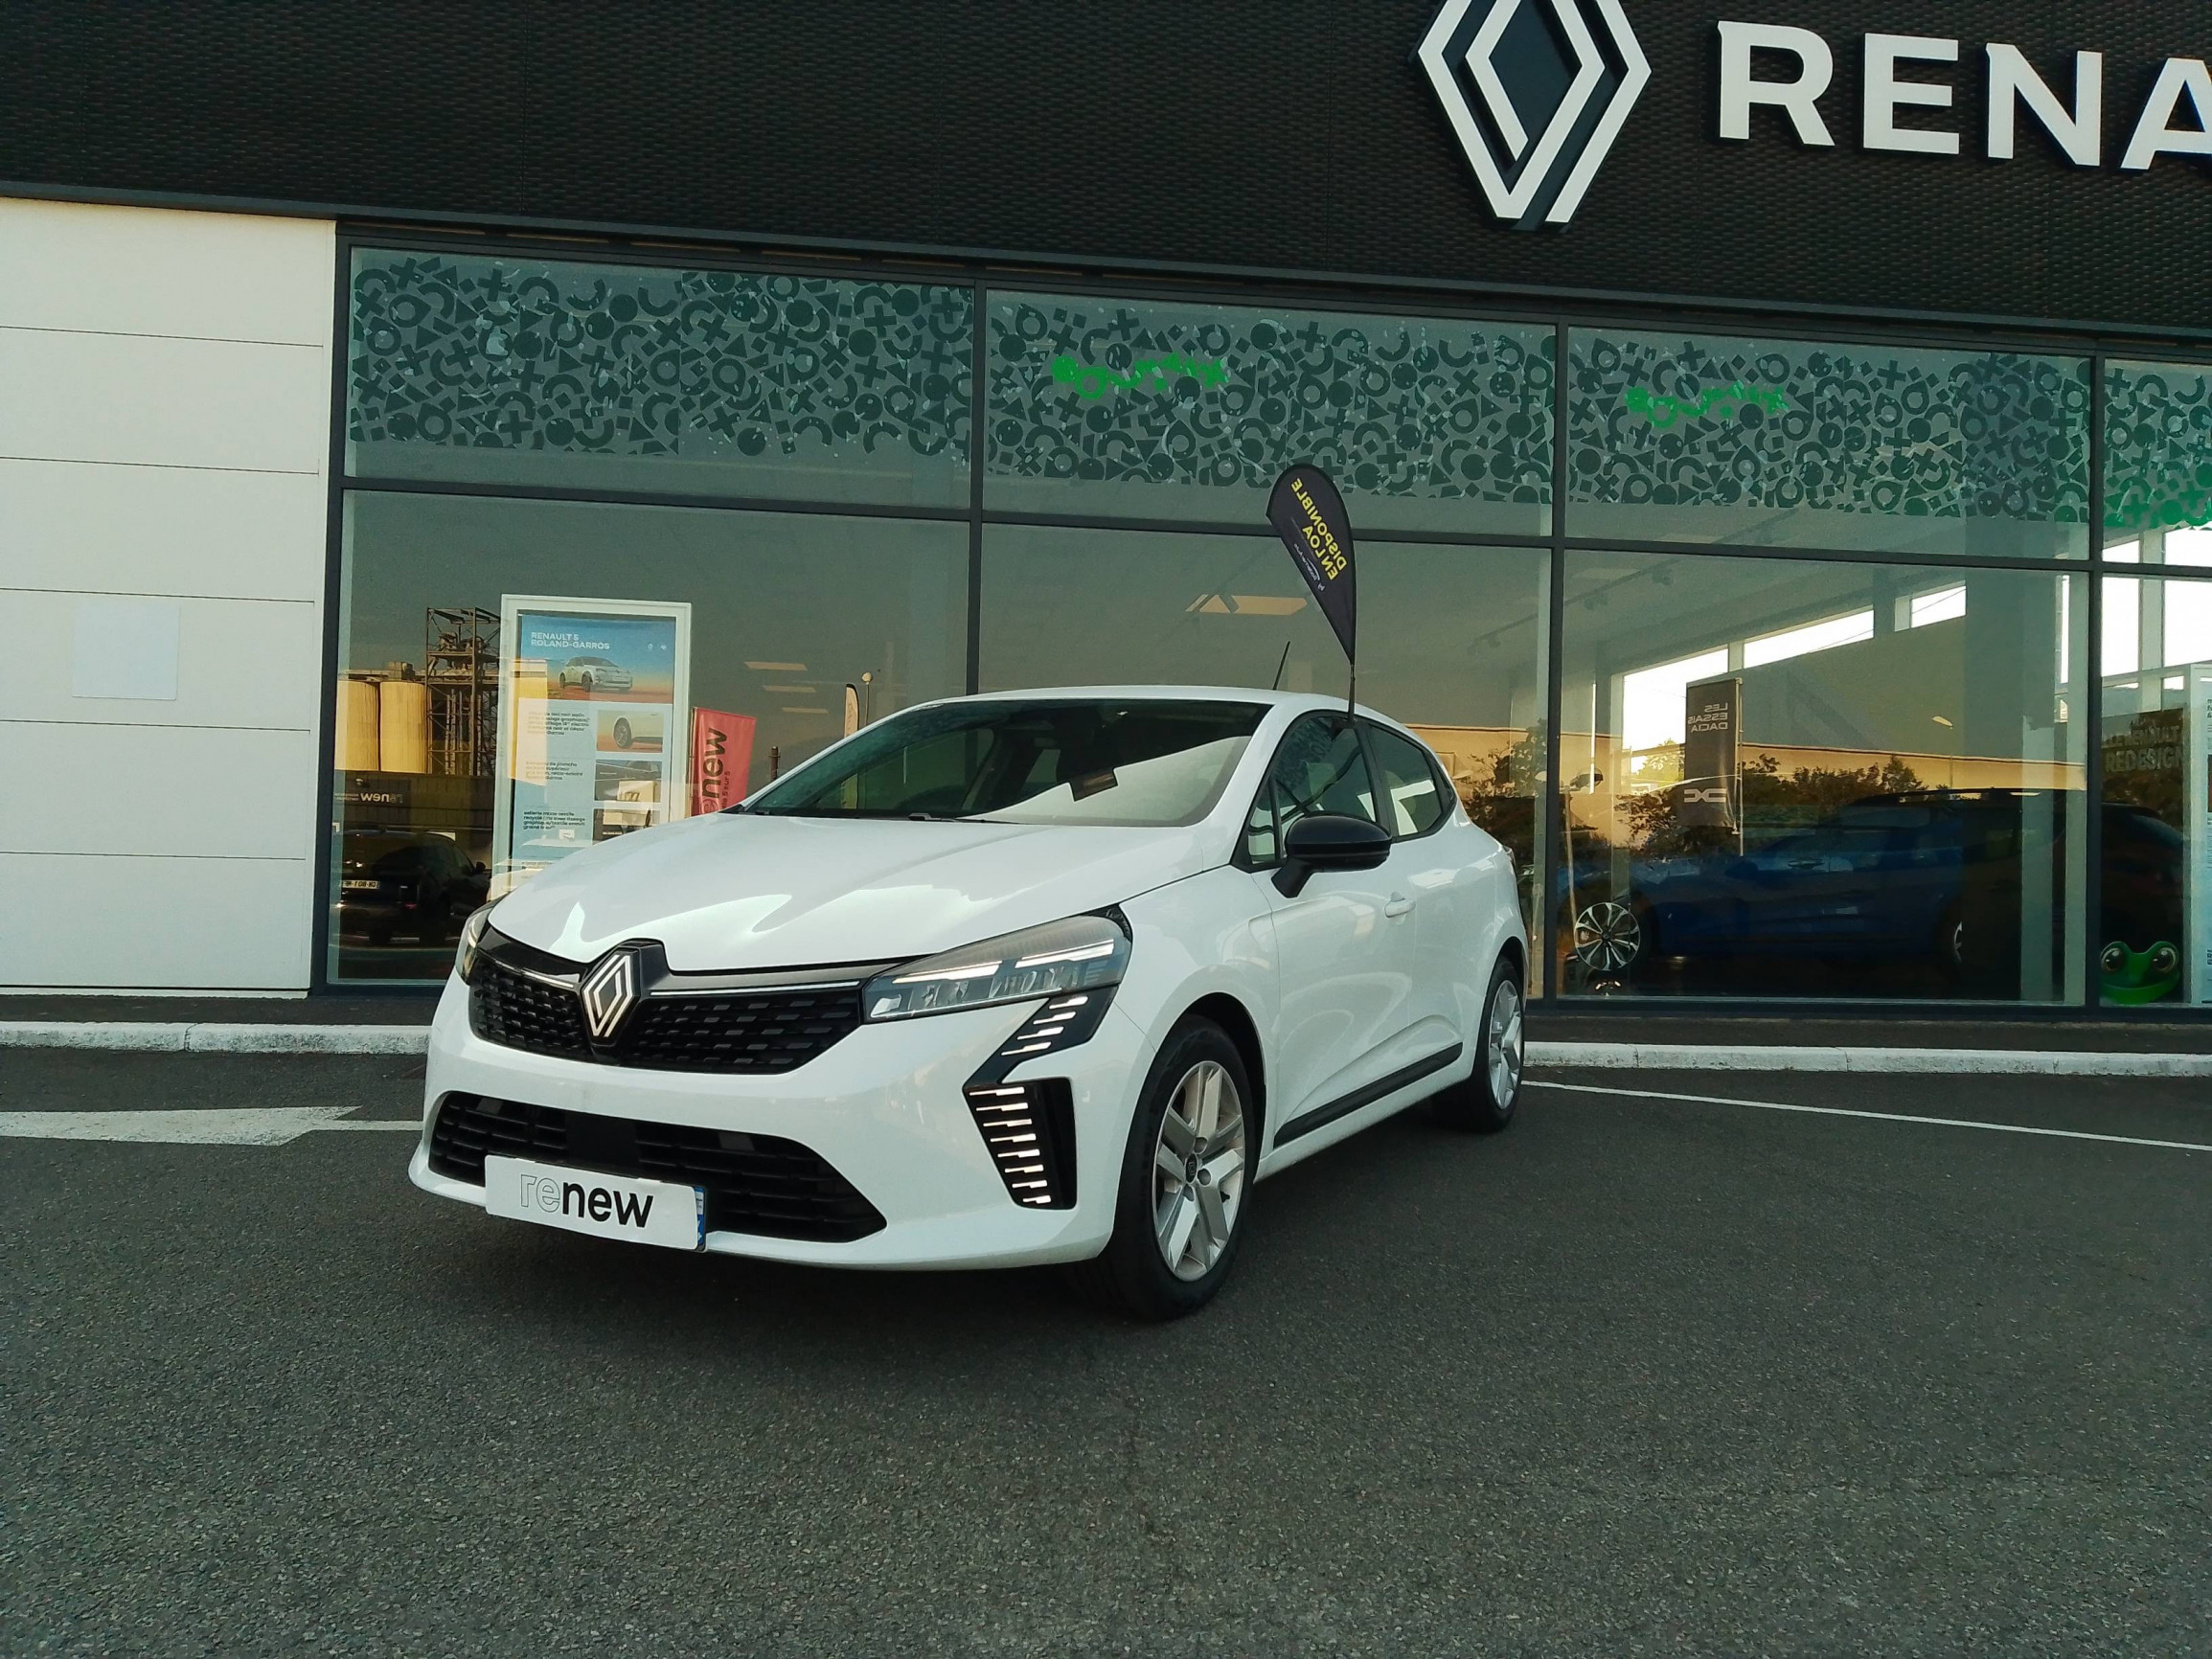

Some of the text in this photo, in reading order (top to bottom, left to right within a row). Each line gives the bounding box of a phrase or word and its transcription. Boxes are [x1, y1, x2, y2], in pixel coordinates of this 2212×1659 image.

[1718, 19, 2212, 170] RENA
[531, 631, 572, 641] RENAULT
[531, 639, 610, 649] ROLAND-GARROS
[702, 727, 728, 813] enew
[519, 1173, 654, 1229] renew
